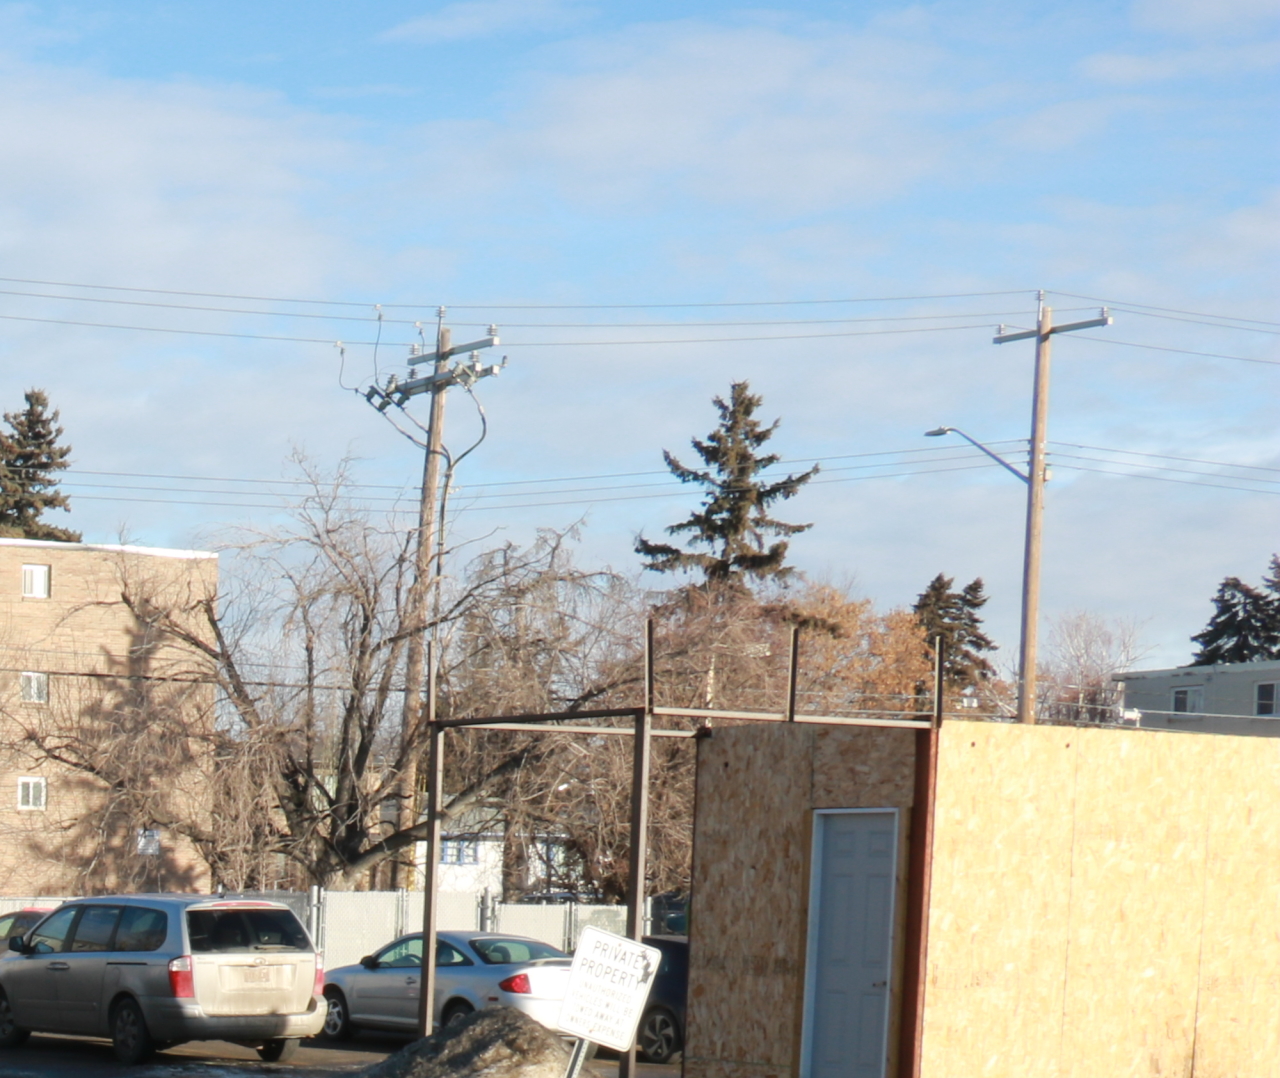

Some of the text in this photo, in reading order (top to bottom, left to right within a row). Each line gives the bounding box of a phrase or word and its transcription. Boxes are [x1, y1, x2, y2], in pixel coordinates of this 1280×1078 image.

[591, 940, 642, 969] PRIVATE
[578, 956, 642, 990] PROPERTY
[578, 978, 632, 1004] UNAUTHORIZED
[594, 1010, 613, 1022] AWAY
[622, 1006, 633, 1017] BE
